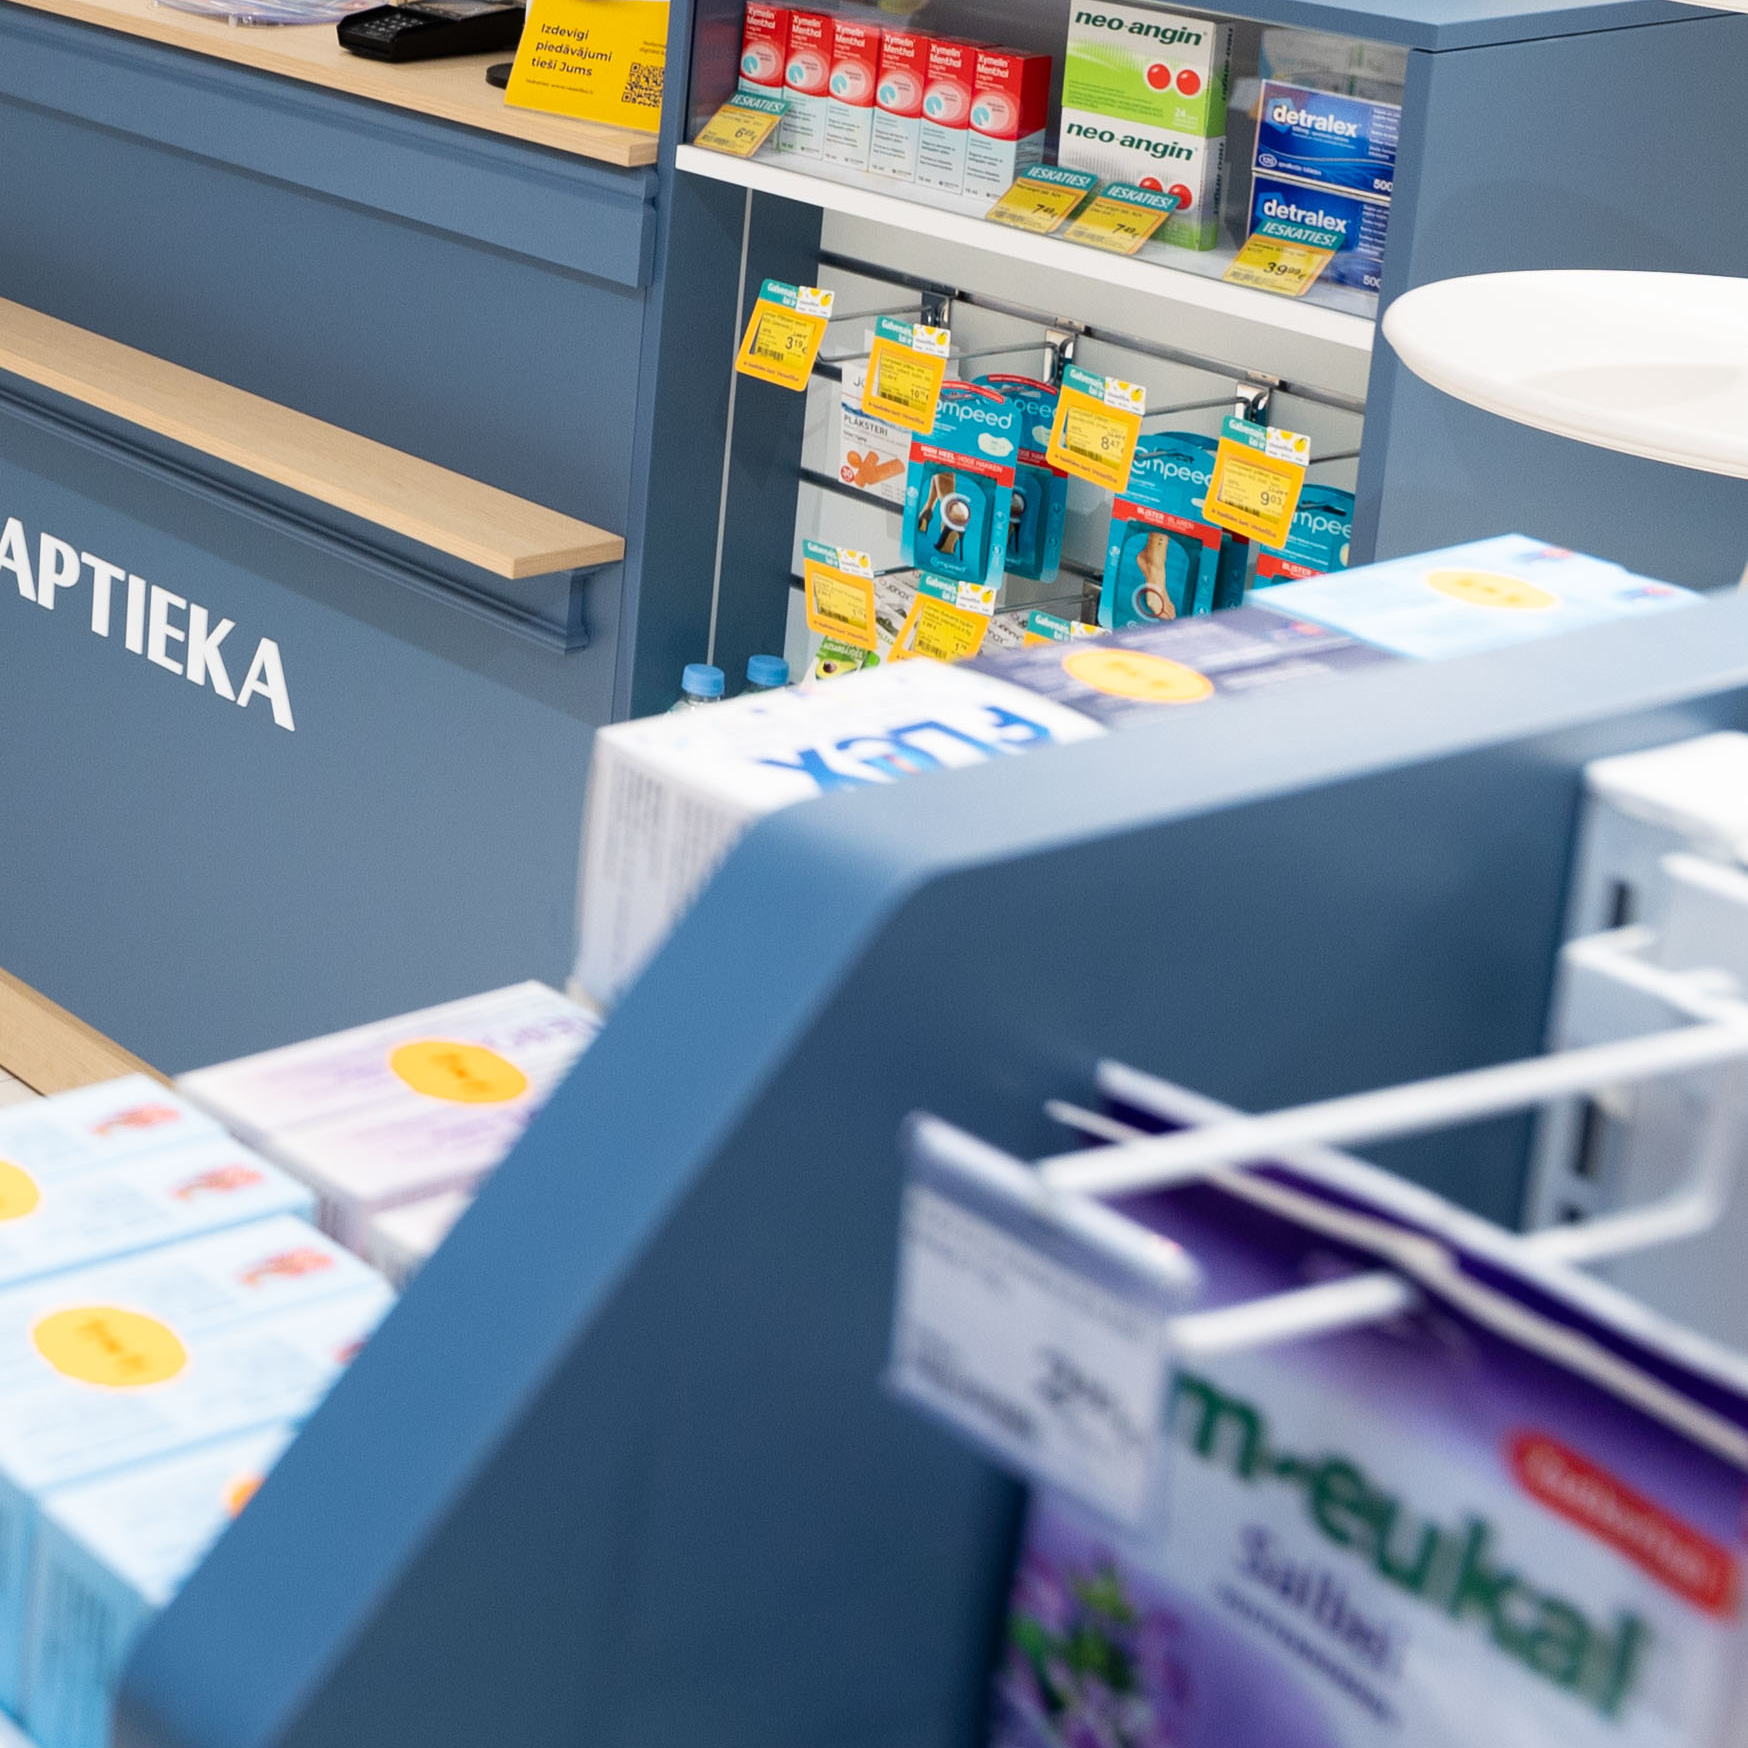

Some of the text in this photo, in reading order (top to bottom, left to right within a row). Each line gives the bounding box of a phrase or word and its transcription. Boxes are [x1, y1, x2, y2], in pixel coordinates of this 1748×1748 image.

[747, 4, 775, 20] Xymelin
[746, 14, 776, 30] Menthol
[792, 14, 823, 29] Xymelin
[541, 23, 589, 41] Izdevīgi
[791, 23, 822, 39] Menthol
[835, 23, 865, 39] Xymelin
[835, 33, 865, 48] Menthol
[884, 32, 914, 47] Xymelin
[536, 41, 613, 62] piedāvājumi
[883, 42, 915, 58] Menthol
[931, 43, 963, 58] Xymelin
[531, 57, 593, 77] tieši Jums
[929, 52, 962, 68] Menthol
[977, 52, 1009, 68] Xymelin
[976, 63, 1009, 79] Menthol
[731, 94, 786, 115] IESKATIES!
[1273, 105, 1359, 139] detralex
[1027, 166, 1092, 187] IESKATIES!
[1373, 179, 1393, 193] 500
[1109, 184, 1174, 211] IESKATIES!
[1263, 192, 1348, 234] detralex
[1262, 221, 1338, 246] IESKATIES!
[935, 400, 1013, 429] ompeed
[844, 414, 888, 437] PLĀKSTERI
[1137, 507, 1164, 520] BLISTER
[1282, 562, 1312, 576] BLISTER
[1163, 1365, 1651, 1727] m-eukal
